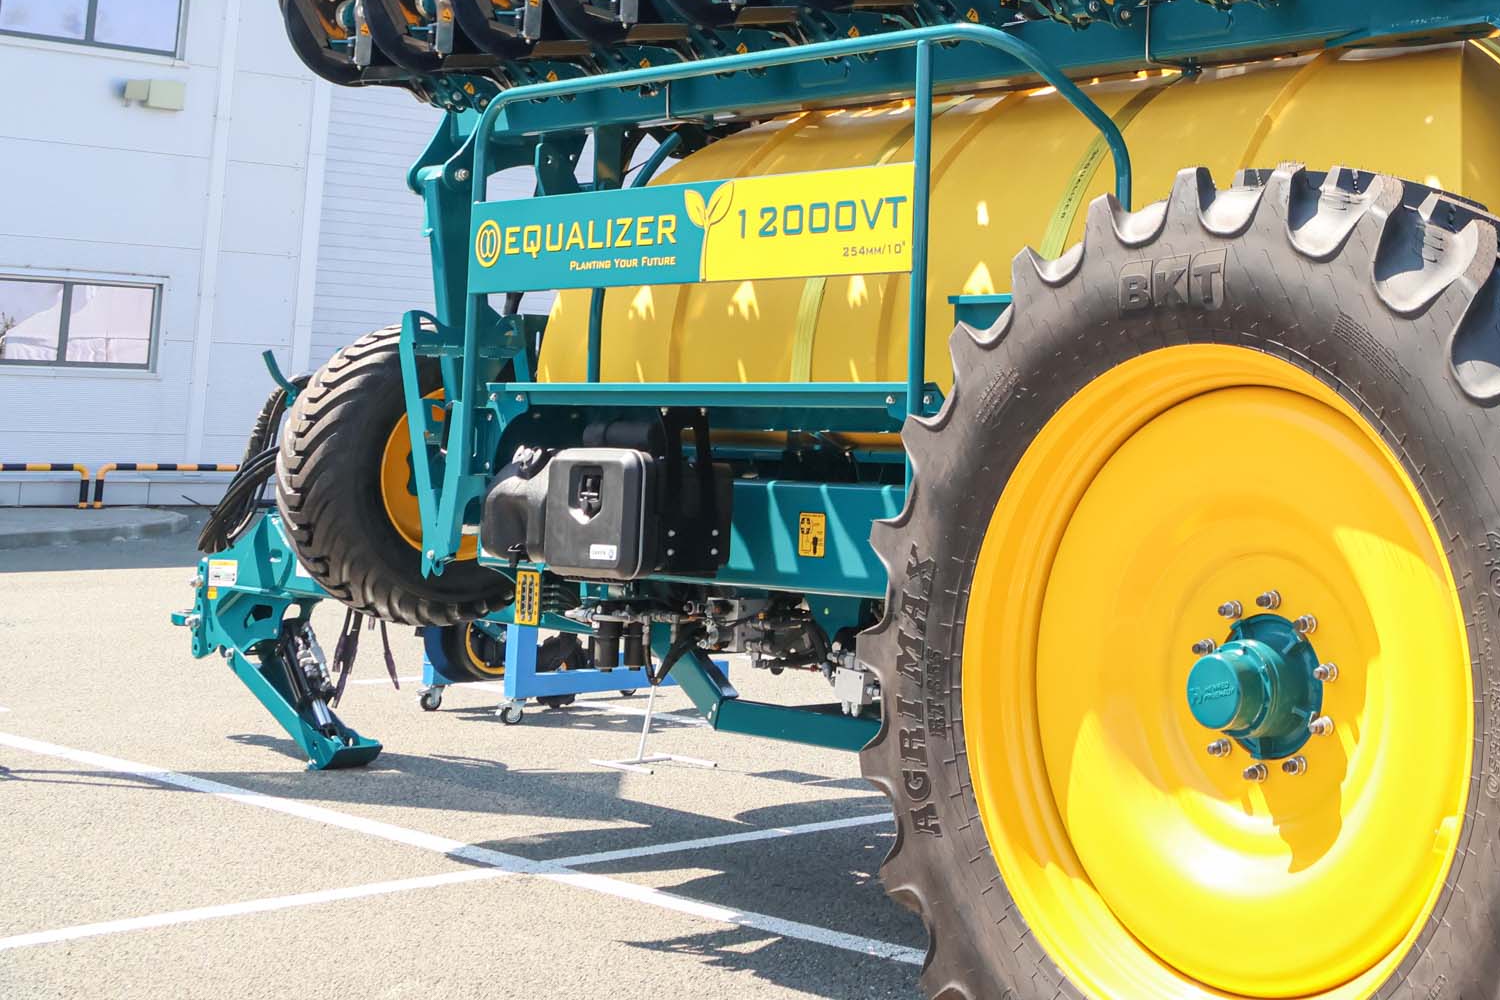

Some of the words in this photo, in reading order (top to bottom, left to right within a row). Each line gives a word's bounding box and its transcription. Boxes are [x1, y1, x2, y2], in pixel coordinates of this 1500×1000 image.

[504, 214, 677, 258] EQUALIZER
[738, 196, 908, 239] 12000VT
[1118, 258, 1225, 311] BKT
